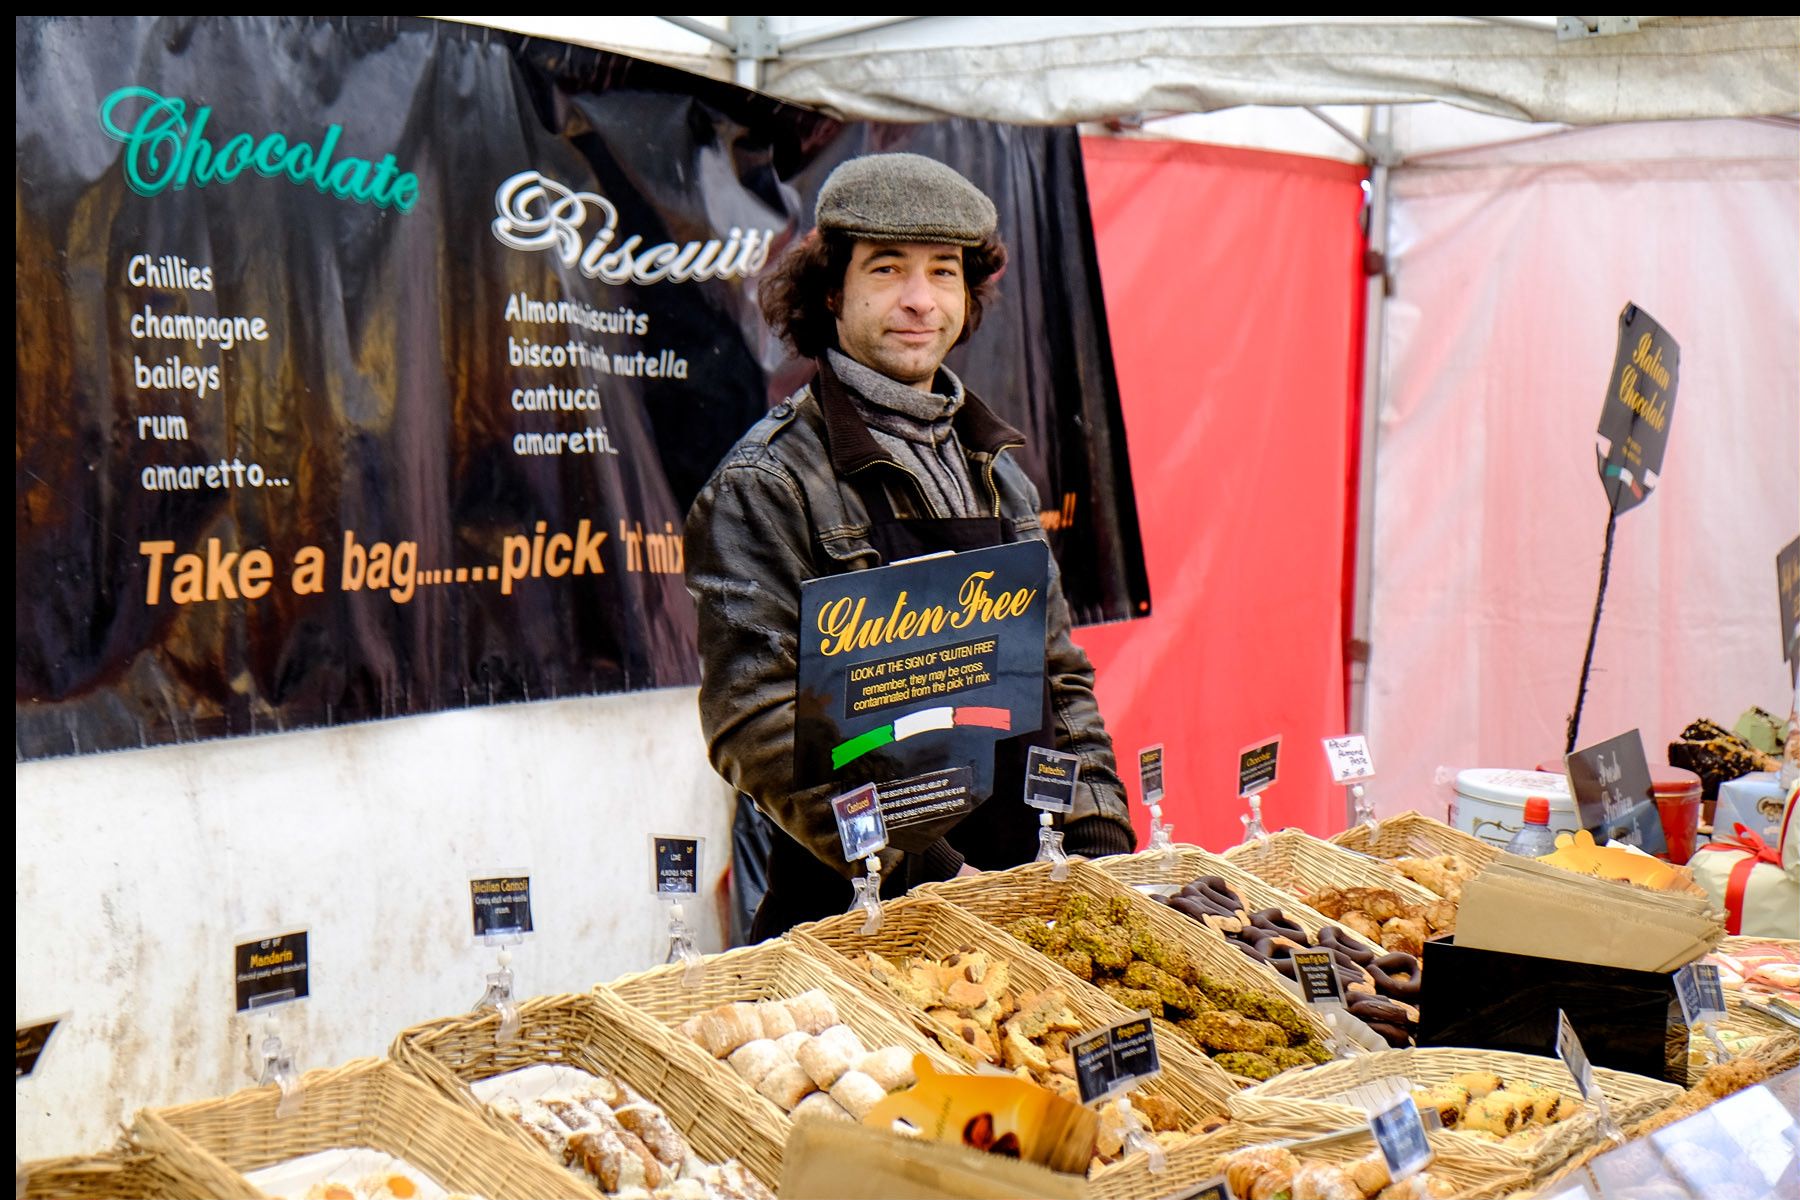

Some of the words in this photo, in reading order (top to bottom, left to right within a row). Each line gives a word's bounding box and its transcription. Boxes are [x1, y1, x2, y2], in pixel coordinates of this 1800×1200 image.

[99, 86, 420, 215] Chocolate
[128, 254, 213, 291] Chillies
[131, 308, 268, 350] champagne
[135, 355, 221, 398] baileys
[613, 350, 688, 379] nutella
[1633, 332, 1671, 391] Italian
[1620, 364, 1666, 432] Chocolate
[138, 413, 188, 441] rum
[142, 459, 290, 492] amaretto...
[139, 538, 274, 606] Take
[291, 541, 324, 594] a
[817, 589, 952, 656] Gluten
[950, 570, 1038, 628] Free
[851, 668, 875, 682] LOOK
[875, 664, 888, 677] AT
[886, 661, 905, 674] THE
[904, 656, 925, 670] SIGN
[925, 653, 938, 665] OF
[862, 677, 908, 697] remember,
[910, 672, 927, 687] they
[928, 668, 947, 683] may
[948, 664, 959, 676] be
[960, 662, 984, 674] cross
[853, 687, 910, 711] contaminated
[911, 683, 931, 697] from
[932, 681, 946, 693] the
[946, 677, 964, 692] pick
[975, 672, 991, 683] mix
[250, 950, 293, 969] Mandarin
